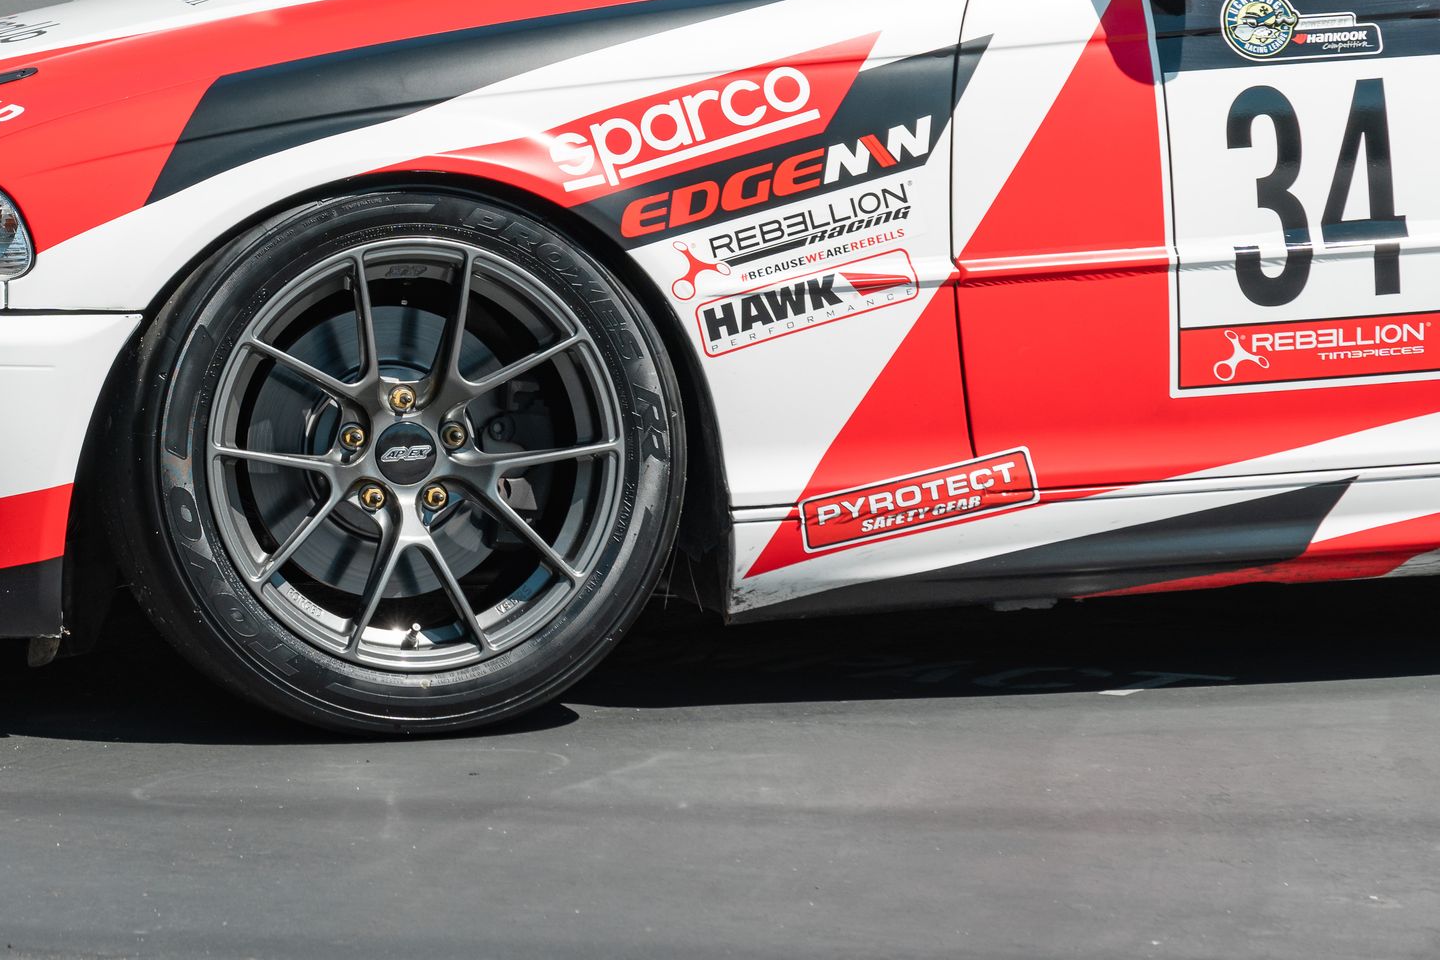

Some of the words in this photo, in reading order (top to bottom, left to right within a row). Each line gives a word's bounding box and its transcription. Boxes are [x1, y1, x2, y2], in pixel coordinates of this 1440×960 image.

[1244, 42, 1268, 54] RACING
[1269, 32, 1288, 51] LEAGUE
[550, 67, 810, 186] sparco
[1226, 77, 1409, 307] 34
[462, 208, 645, 360] PROXES
[703, 273, 843, 342] HAWK
[711, 287, 913, 353] PERFORMANCE
[383, 447, 429, 460] APEX
[817, 461, 1015, 525] PYROTECT
[861, 506, 929, 533] SAFETY
[932, 495, 981, 516] GEAR
[169, 486, 300, 677] TOYO
